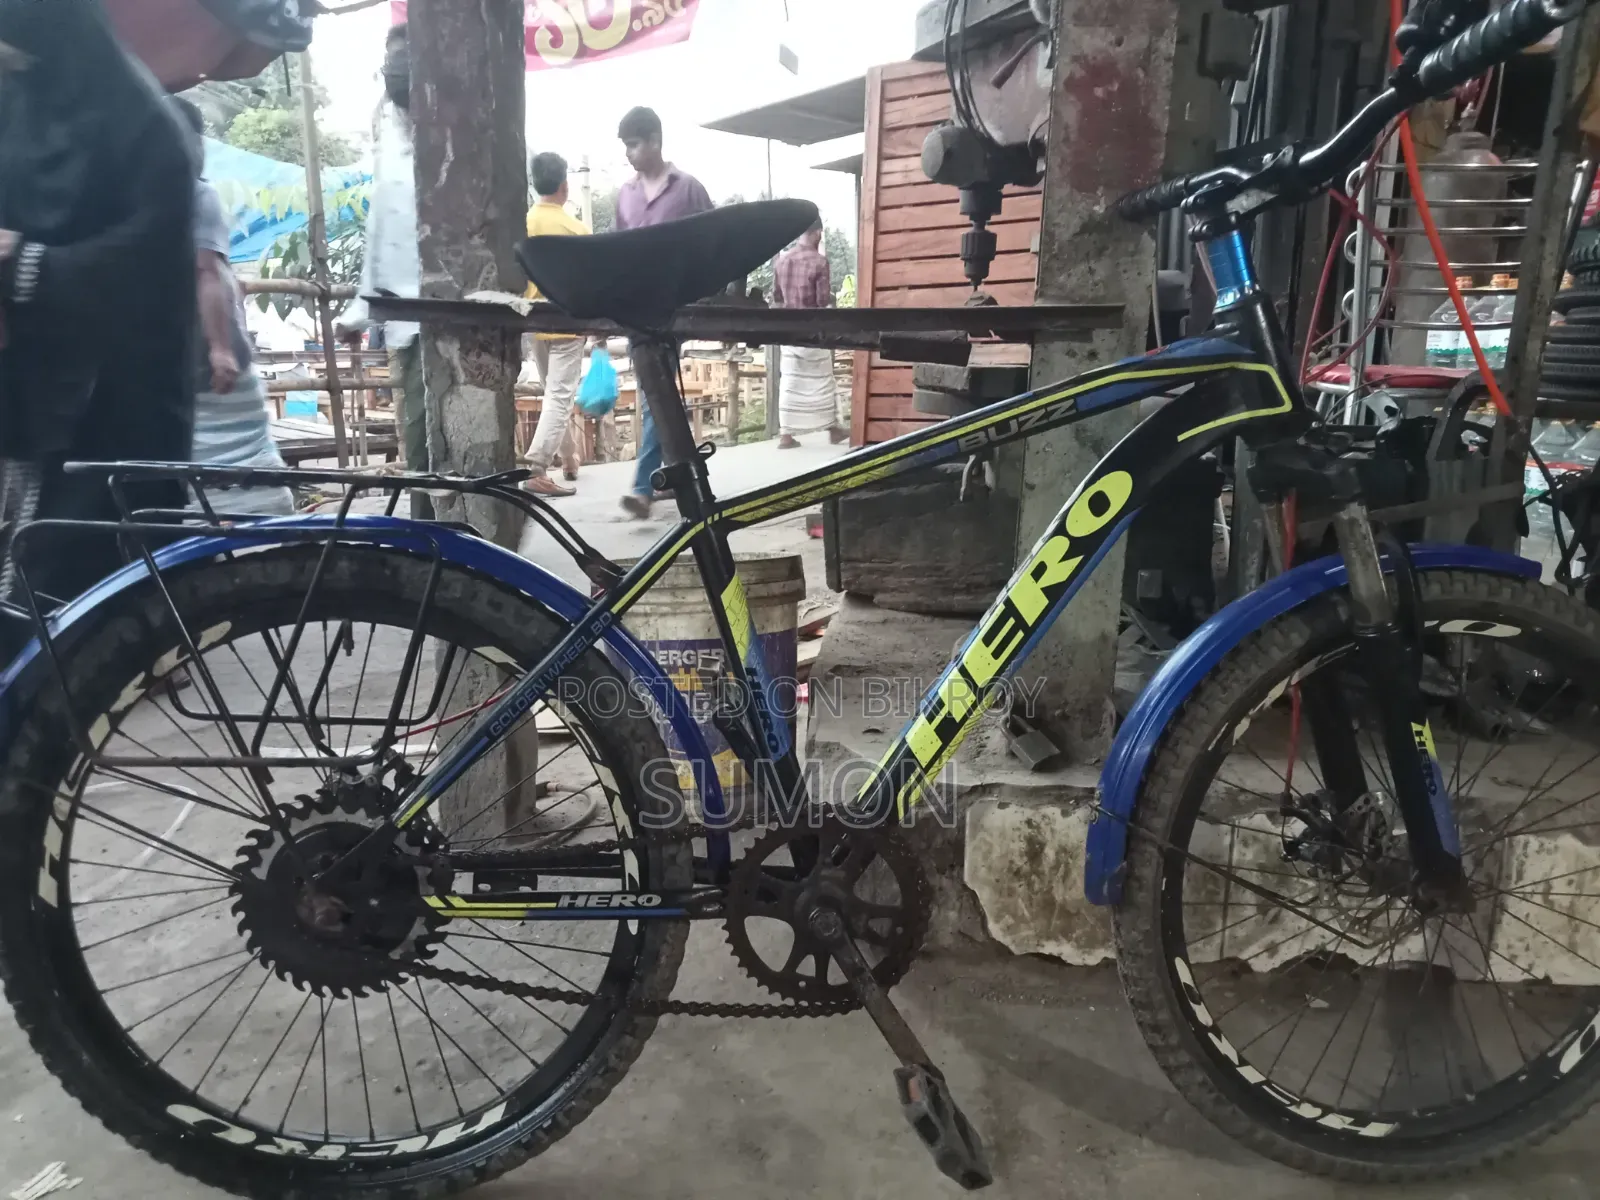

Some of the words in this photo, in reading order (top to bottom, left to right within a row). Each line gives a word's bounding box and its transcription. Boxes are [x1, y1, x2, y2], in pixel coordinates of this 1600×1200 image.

[958, 398, 1077, 453] BUZZ
[904, 470, 1133, 770] HERO
[489, 680, 547, 737] GOLDEN
[543, 635, 593, 682] WHEEL
[590, 611, 612, 636] BD
[650, 648, 726, 672] ERGER
[744, 667, 779, 753] HERO
[558, 894, 662, 908] HERO
